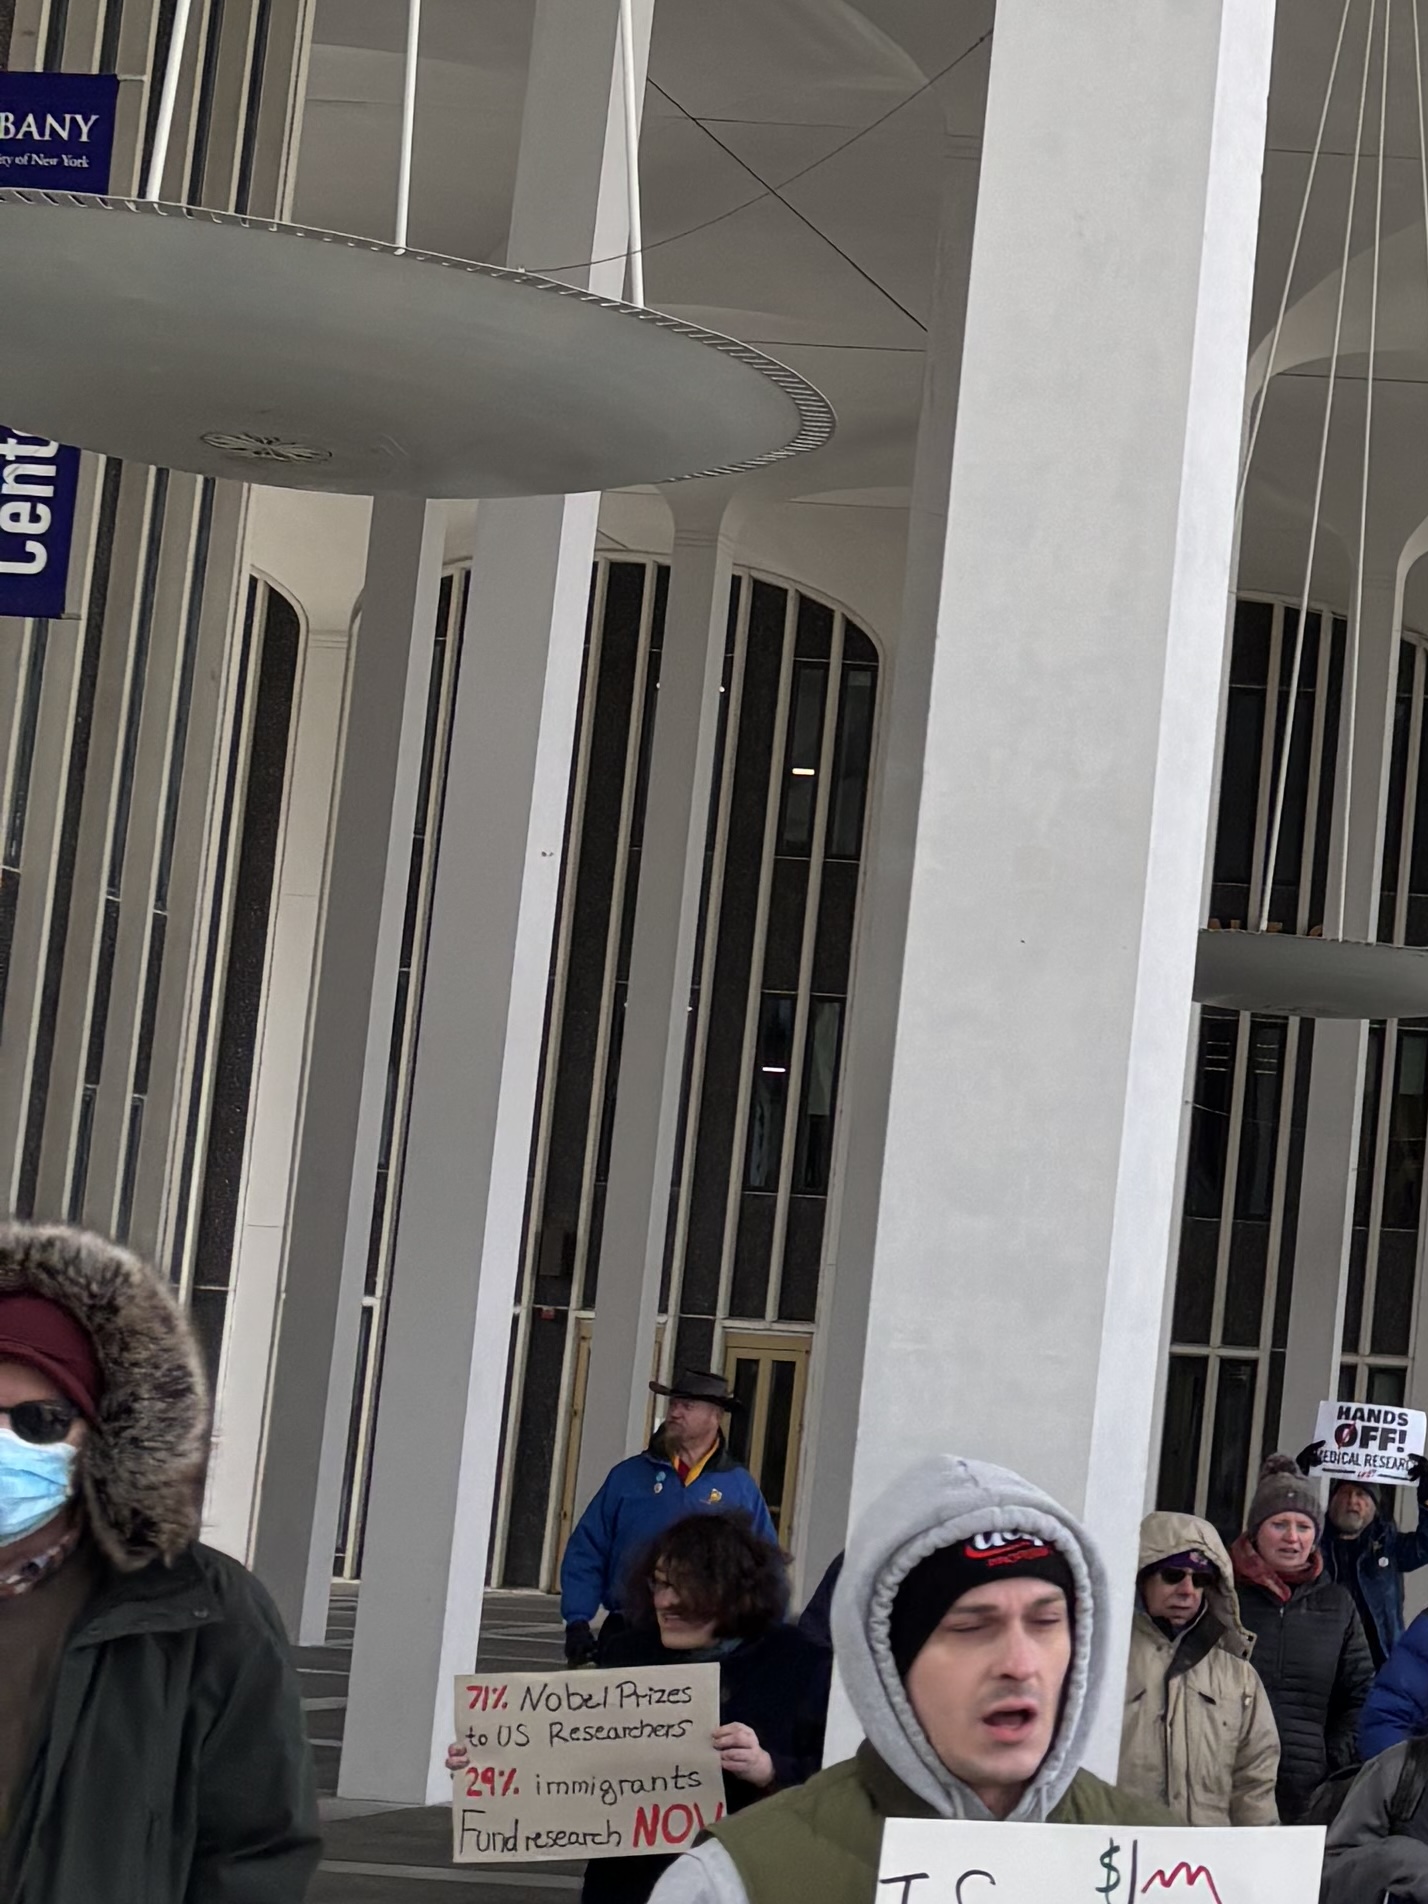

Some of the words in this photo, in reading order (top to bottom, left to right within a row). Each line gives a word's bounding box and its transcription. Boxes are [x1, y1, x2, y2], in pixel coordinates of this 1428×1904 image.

[15, 153, 29, 165] of
[31, 154, 58, 166] New
[62, 155, 89, 168] York
[0, 425, 59, 574] Cent
[1337, 1405, 1408, 1427] HANDS
[1334, 1421, 1407, 1453] OFF!
[466, 1685, 508, 1712] 71%
[520, 1683, 608, 1712] Nobel
[616, 1681, 692, 1708] Prizes
[465, 1727, 488, 1747] to
[498, 1723, 530, 1746] US
[549, 1719, 693, 1746] Researchers
[465, 1767, 519, 1797] 29%
[536, 1765, 702, 1805] immigrants
[460, 1809, 517, 1854] Fund
[525, 1820, 622, 1852] research
